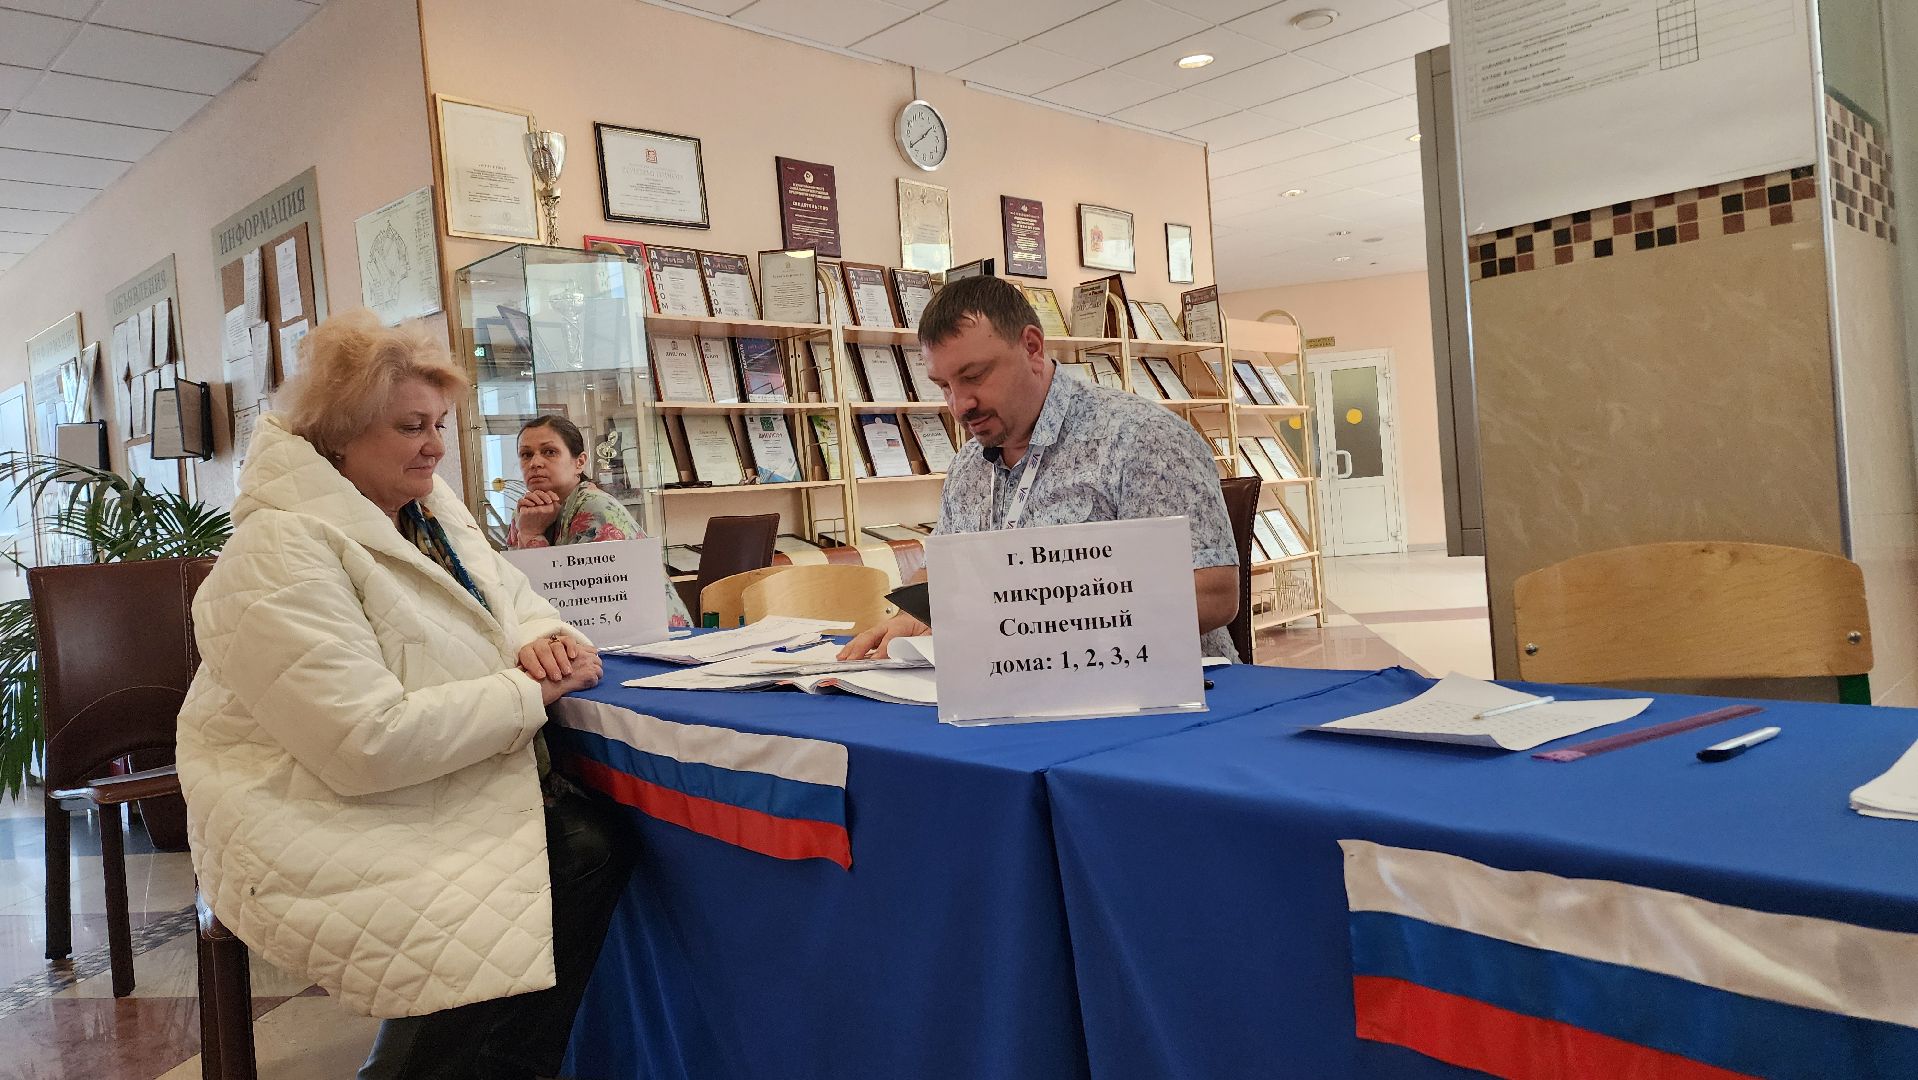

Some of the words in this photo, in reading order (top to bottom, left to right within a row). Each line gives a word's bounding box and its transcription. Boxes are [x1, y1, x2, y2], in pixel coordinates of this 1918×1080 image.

[219, 186, 306, 255] ИНФОРМАЦИЯ
[112, 270, 167, 315] ОБЪЯВЛЕНИЯ
[552, 559, 563, 568] г.
[567, 553, 616, 568] Видное
[1007, 552, 1024, 566] г.
[1031, 544, 1113, 565] Видное
[543, 573, 628, 591] микрорайон
[993, 577, 1133, 605] микрорайон
[548, 591, 628, 609] Солнечный
[565, 617, 595, 627] ома:
[599, 613, 611, 626] 5,
[615, 611, 622, 623] 6
[999, 609, 1133, 637] Солнечный
[989, 655, 1052, 677] дома:
[1060, 651, 1079, 672] 1,
[1085, 648, 1104, 669] 2,
[1111, 646, 1130, 668] 3,
[1136, 644, 1148, 663] 4
